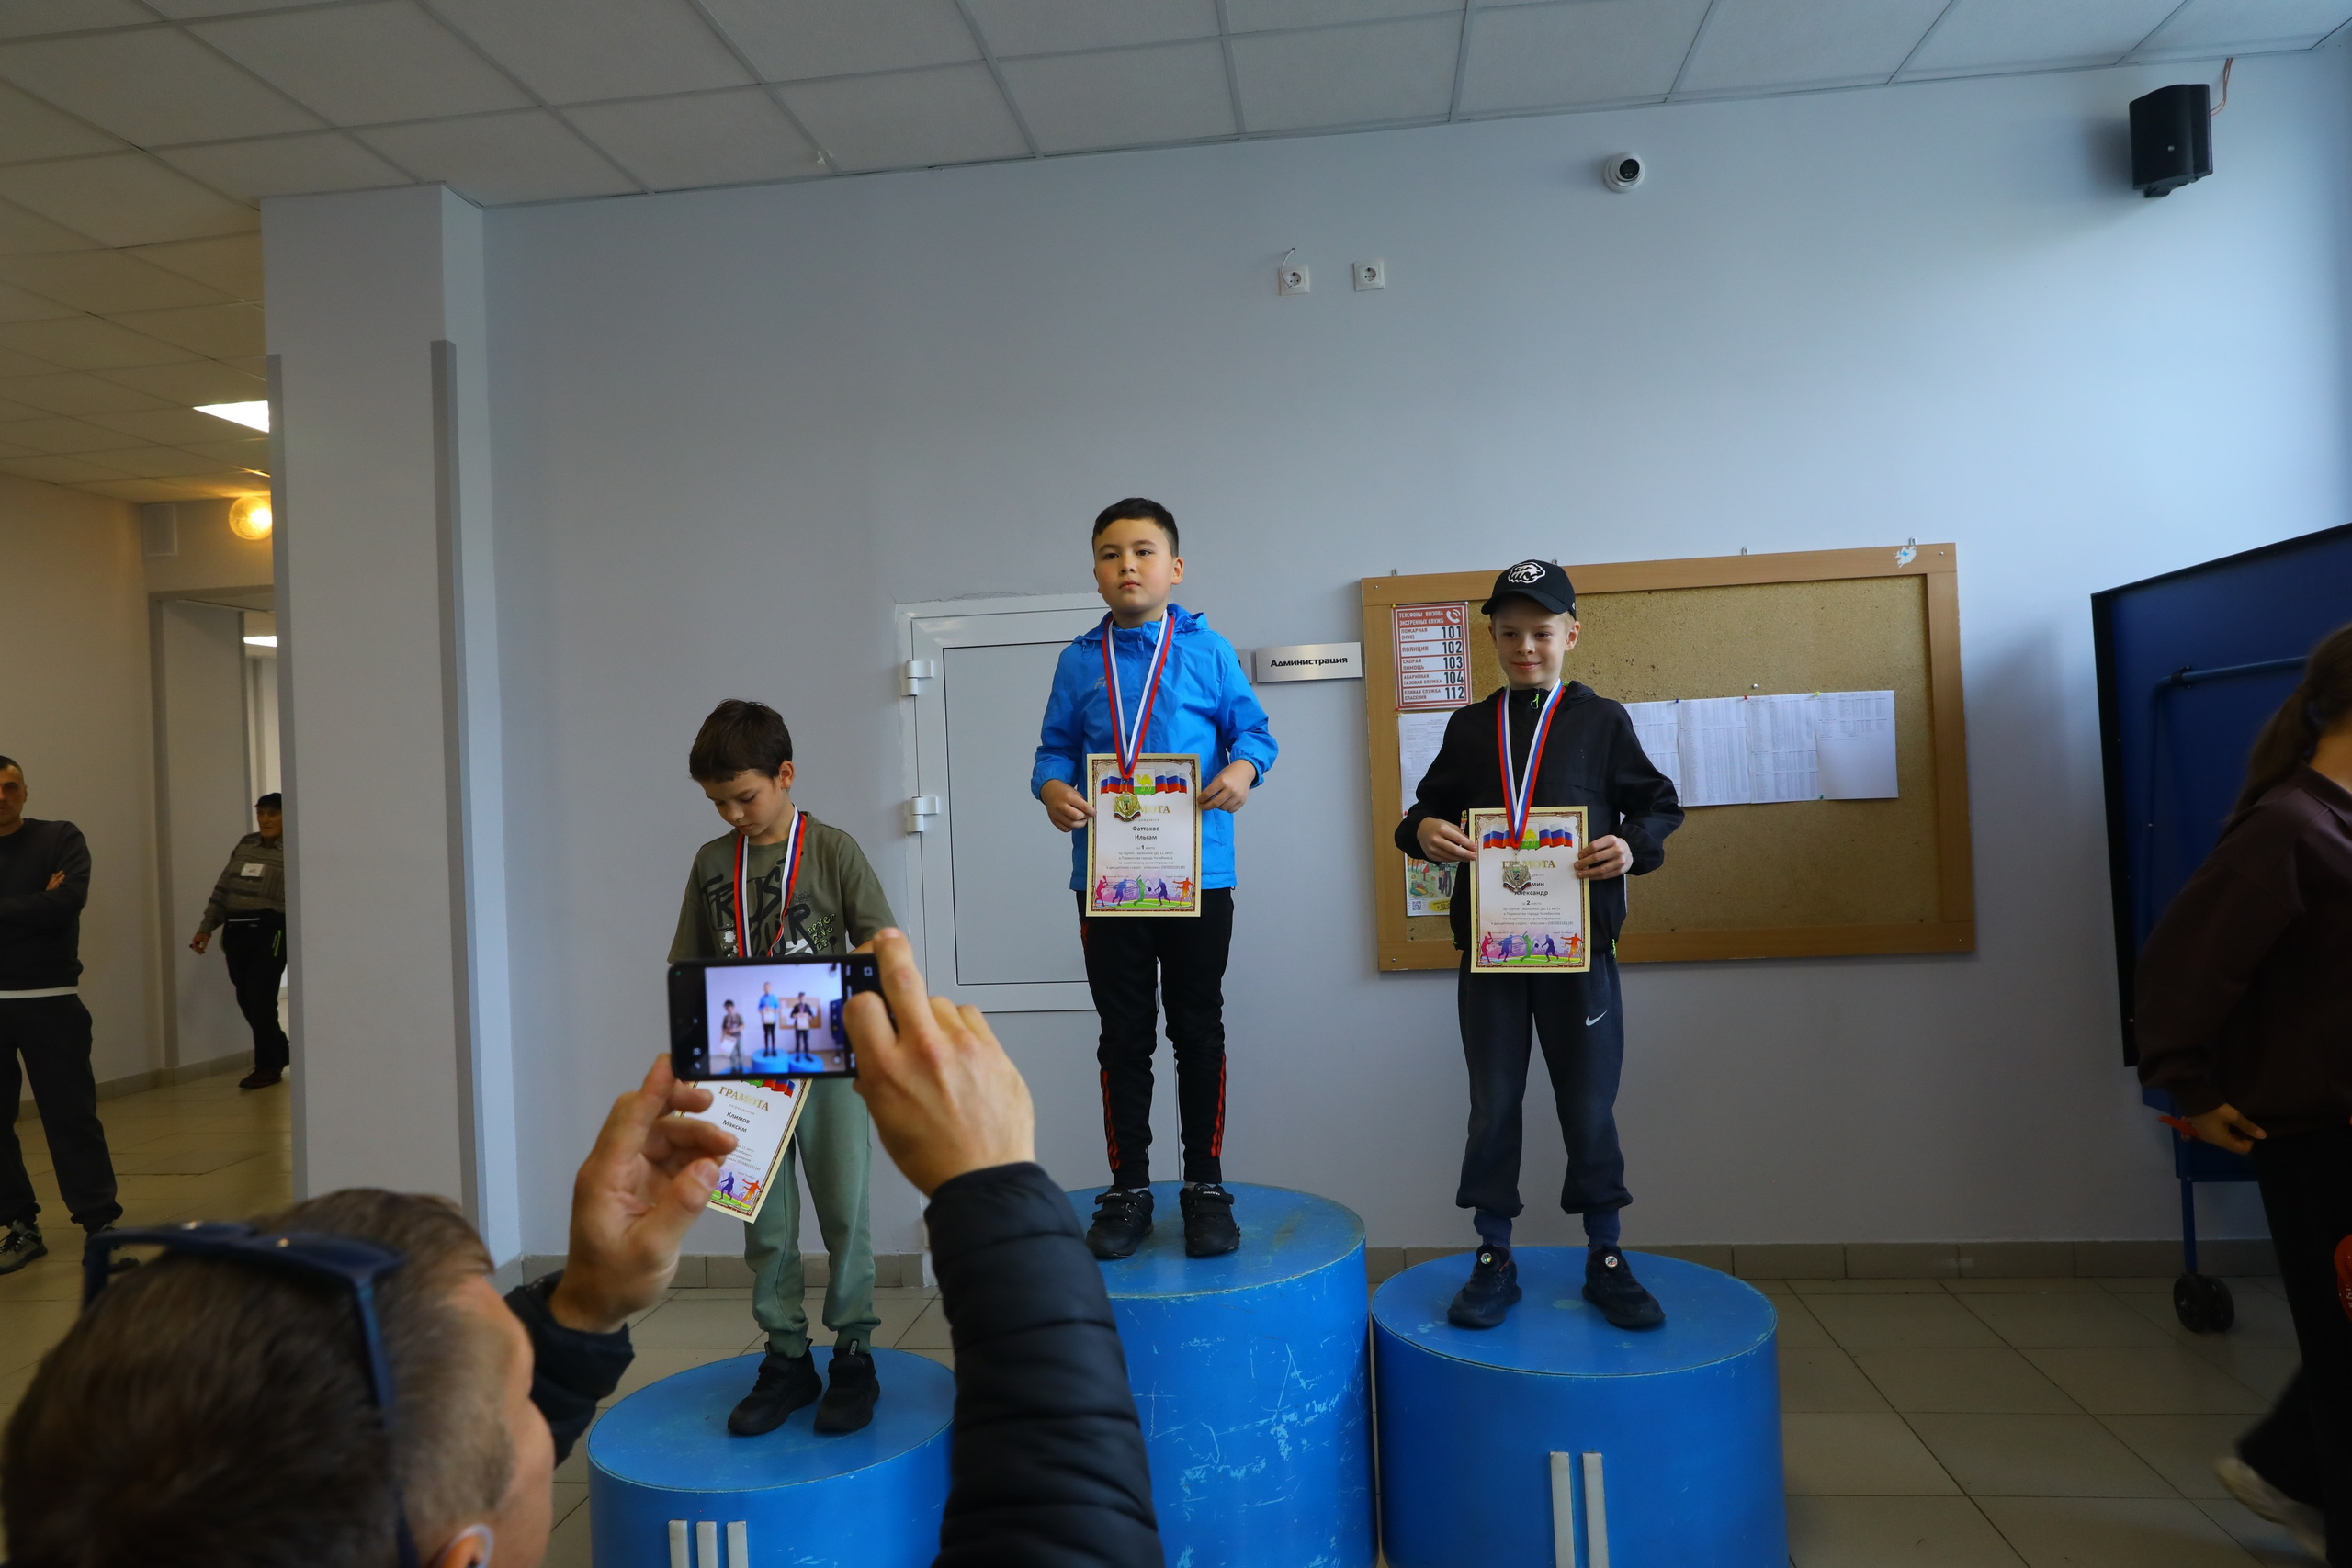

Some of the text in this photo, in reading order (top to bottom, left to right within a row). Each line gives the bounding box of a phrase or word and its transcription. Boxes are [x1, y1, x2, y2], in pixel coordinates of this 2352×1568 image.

[1442, 626, 1462, 639] 101
[1442, 640, 1463, 654] 102
[1270, 657, 1348, 667] Администрация
[1443, 656, 1463, 670] 103
[1444, 671, 1464, 684] 104
[1445, 686, 1464, 699] 112
[718, 1086, 770, 1111] ГРАМОТА
[727, 1111, 750, 1124] Климов
[722, 1119, 747, 1133] Максим
